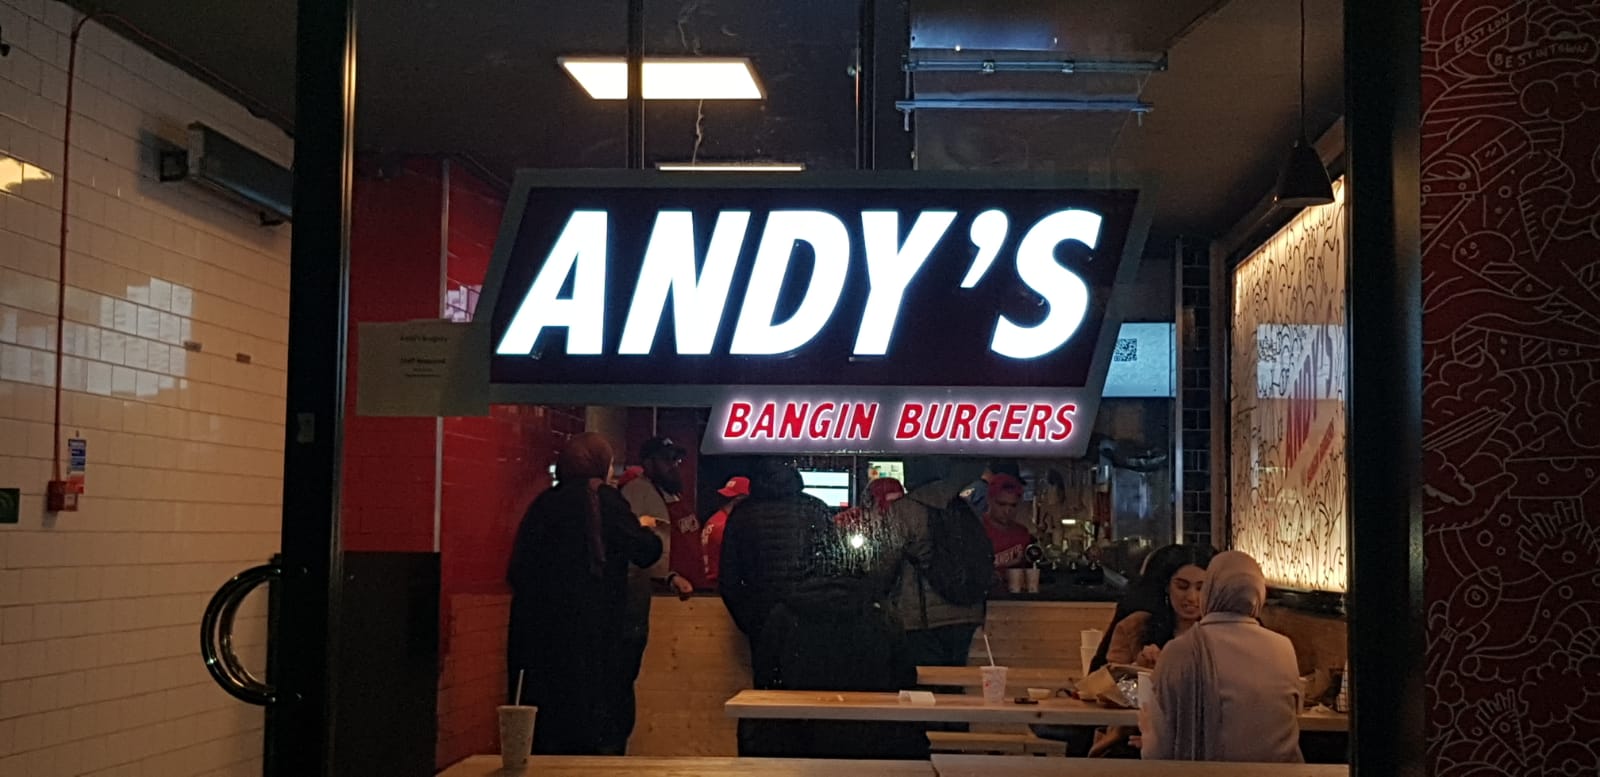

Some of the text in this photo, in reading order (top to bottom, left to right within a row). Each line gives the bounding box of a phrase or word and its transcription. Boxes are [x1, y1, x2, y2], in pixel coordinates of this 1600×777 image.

[1454, 28, 1485, 53] EAST
[1494, 50, 1533, 69] BEST
[1551, 42, 1589, 55] TOWN
[496, 210, 1102, 359] ANDY'S
[722, 401, 1077, 442] BANGIN BURGERS
